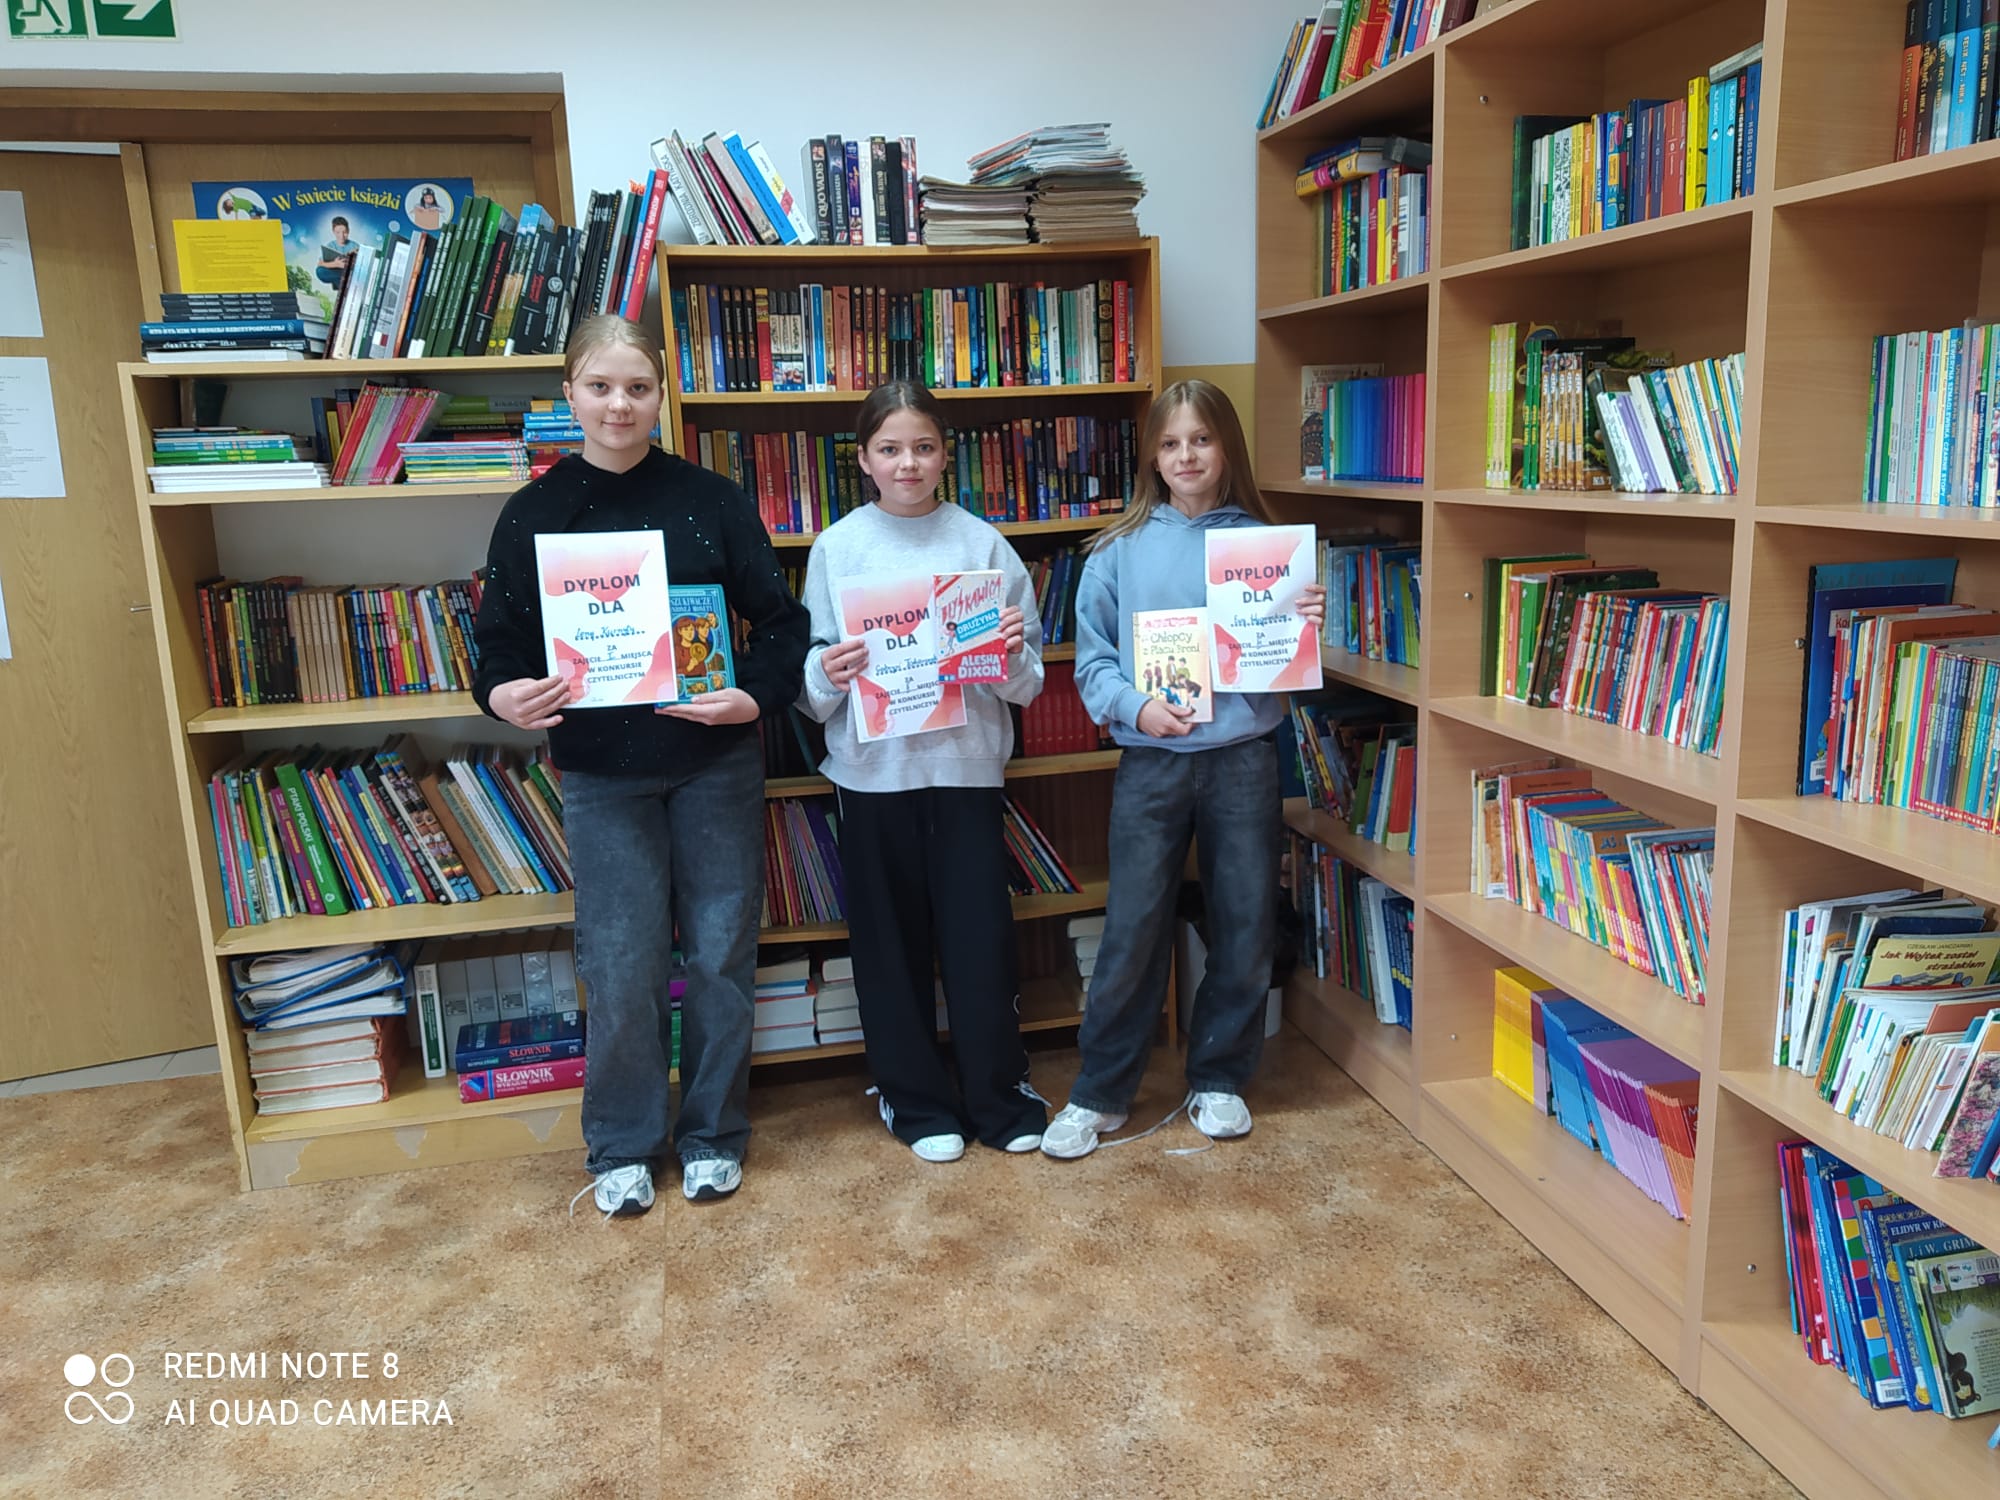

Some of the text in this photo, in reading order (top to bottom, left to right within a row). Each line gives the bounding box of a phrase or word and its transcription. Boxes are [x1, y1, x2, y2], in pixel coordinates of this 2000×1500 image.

[814, 162, 828, 218] QUO VADIS
[271, 186, 402, 213] W świecie książki
[1224, 564, 1290, 582] DYPLOM
[564, 574, 641, 593] DYPLOM
[1242, 589, 1274, 604] DLA
[588, 600, 625, 616] DLA
[863, 607, 930, 632] DYPLOM
[957, 611, 998, 635] DRUŻYNA
[886, 634, 919, 651] DLA
[1150, 631, 1193, 646] Chłopcy
[1268, 637, 1299, 647] MIEJSCA
[620, 651, 653, 660] MIEJSCA
[961, 654, 1000, 667] ALESHA
[1248, 648, 1289, 659] KONKURSIE
[588, 662, 642, 673] W KONKURSIE
[1239, 657, 1293, 668] CZYTELNICZYM
[587, 671, 646, 684] CZYTELNICZYM
[958, 665, 1001, 680] DIXON
[916, 681, 939, 691] MIEJSC
[897, 691, 936, 705] KONKURSIE
[889, 700, 940, 716] CZYTELNICZYM
[288, 787, 303, 814] PTAKI
[297, 813, 314, 843] POLSKI
[1880, 950, 1980, 962] Jak Wojtek został
[1925, 961, 1986, 971] strażakiem
[509, 1045, 552, 1059] SŁOWNIK
[495, 1067, 553, 1084] SŁOWNIK
[1890, 1223, 1921, 1237] ELIDYR
[1922, 1221, 1932, 1231] W
[1924, 1242, 1940, 1256] W.
[1943, 1237, 1979, 1252] GRIM
